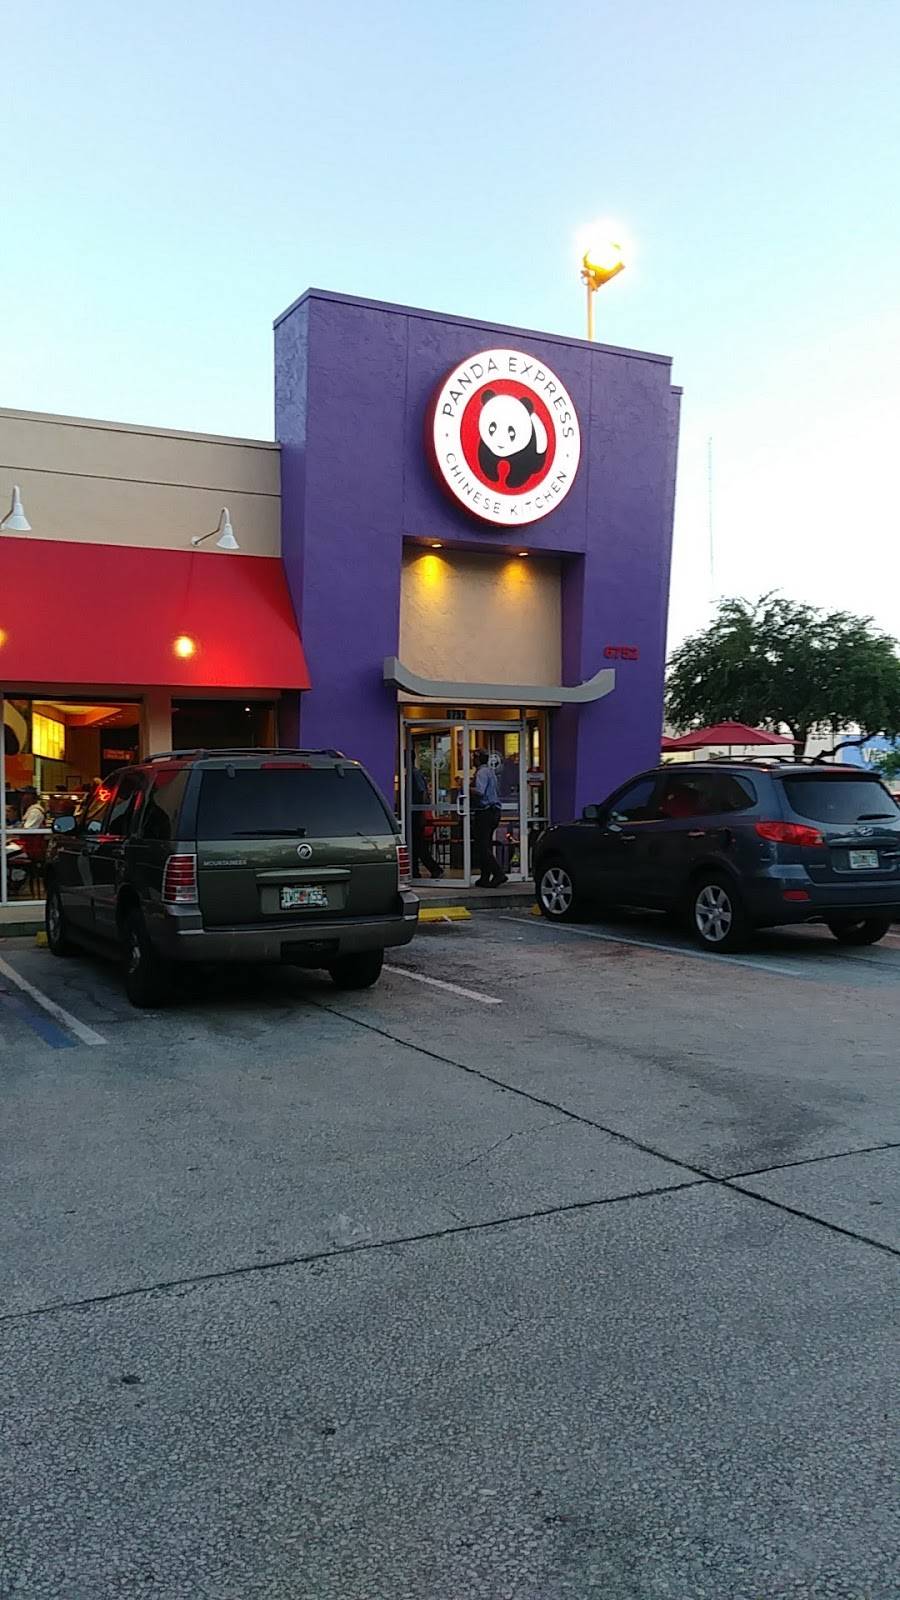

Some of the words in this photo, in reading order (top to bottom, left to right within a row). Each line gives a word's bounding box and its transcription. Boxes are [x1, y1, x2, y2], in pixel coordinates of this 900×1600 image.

[442, 357, 499, 418] PANDA
[508, 357, 575, 438] EXPRESS
[446, 452, 501, 514] CHINESE
[510, 471, 568, 516] KCHEN
